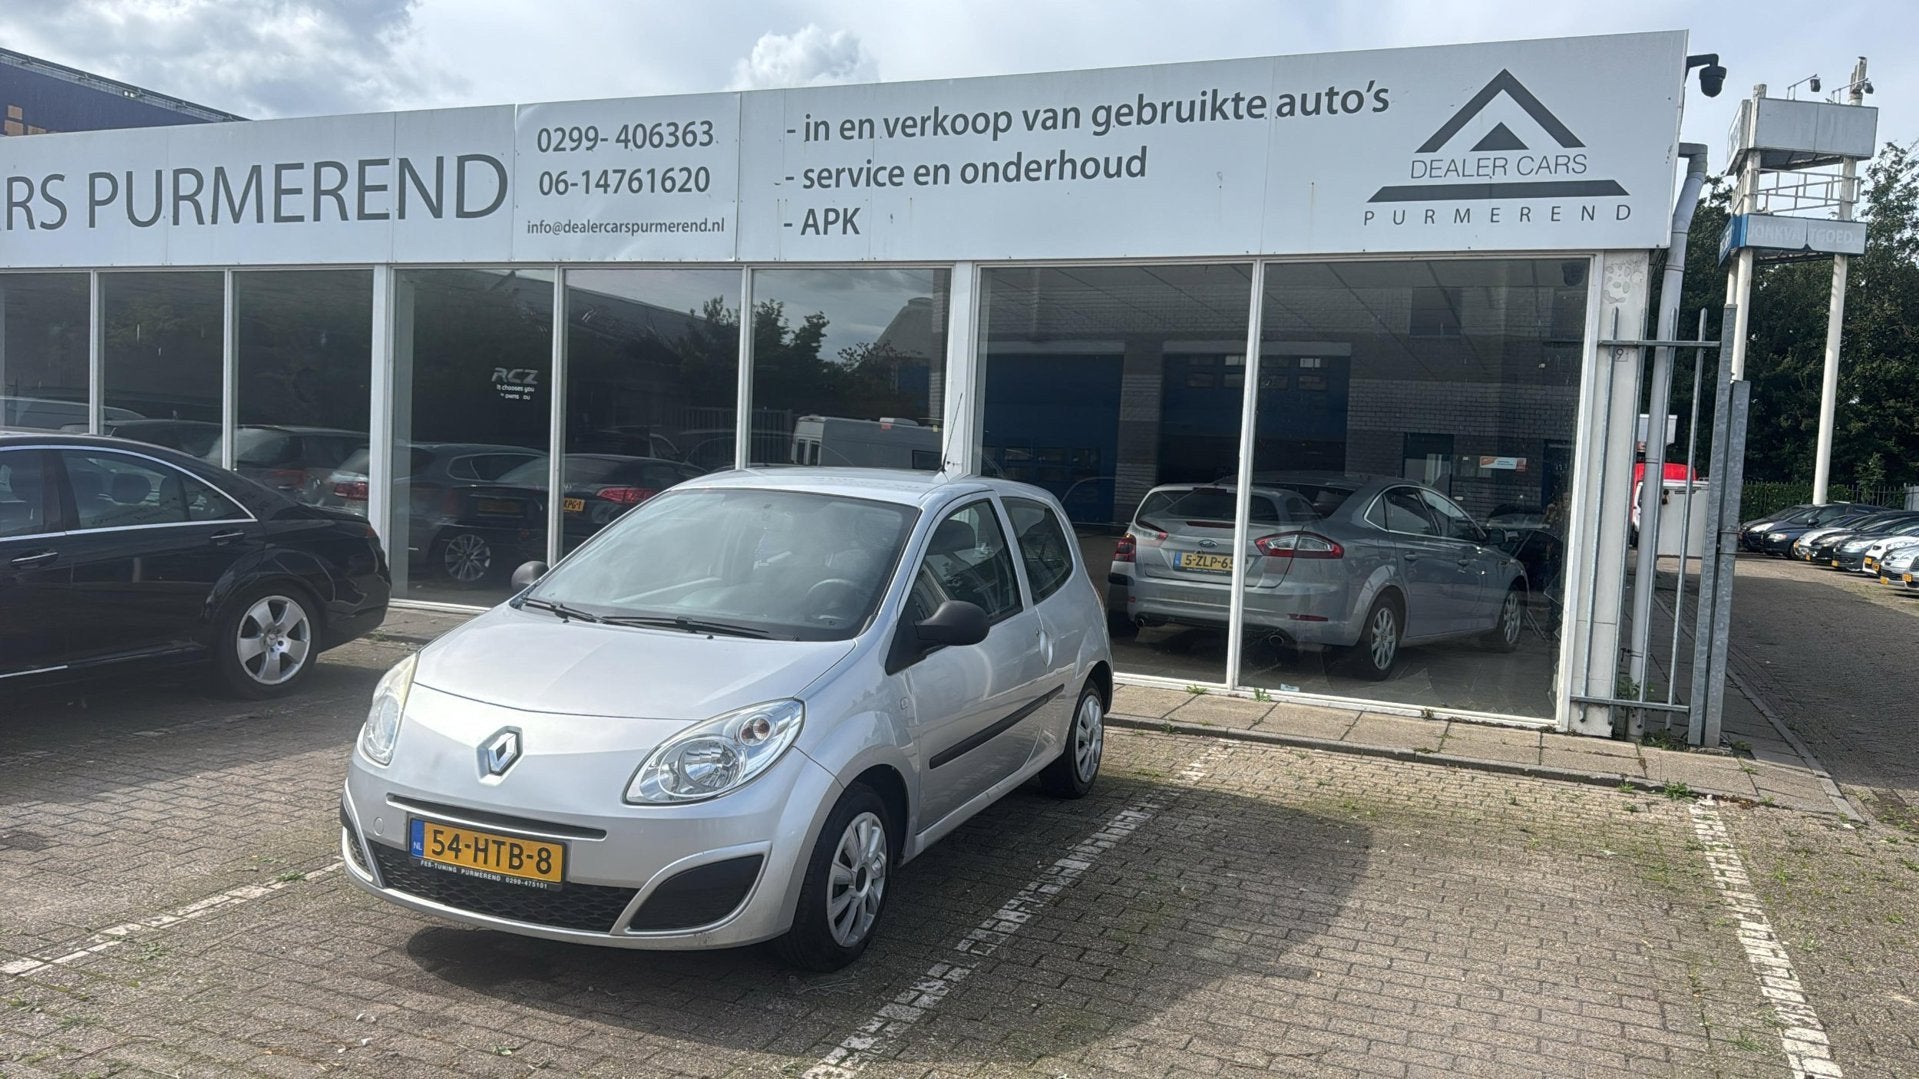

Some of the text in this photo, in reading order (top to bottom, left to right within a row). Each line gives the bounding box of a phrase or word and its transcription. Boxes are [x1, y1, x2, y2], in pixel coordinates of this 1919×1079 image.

[804, 113, 829, 142] in
[839, 117, 875, 140] en
[883, 106, 1013, 141] verkoop
[1022, 106, 1081, 131] van
[1092, 89, 1267, 136] gebruikte
[1276, 80, 1390, 117] auto's
[615, 120, 714, 149] 406363
[803, 159, 905, 189] service
[913, 163, 951, 186] en
[960, 145, 1147, 184] onderhoud
[1410, 154, 1588, 179] DEALER CARS
[88, 154, 509, 229] PURMEREND
[539, 166, 711, 196] 06-14761620
[527, 217, 725, 237] info@dealercarspurmerend.nl
[800, 208, 861, 235] APK
[1363, 204, 1632, 226] PURMEREND
[491, 367, 538, 385] RCZ
[501, 384, 524, 392] chooses
[413, 829, 552, 875] NL 54-HTB-8
[461, 868, 501, 882] PURMEREND
